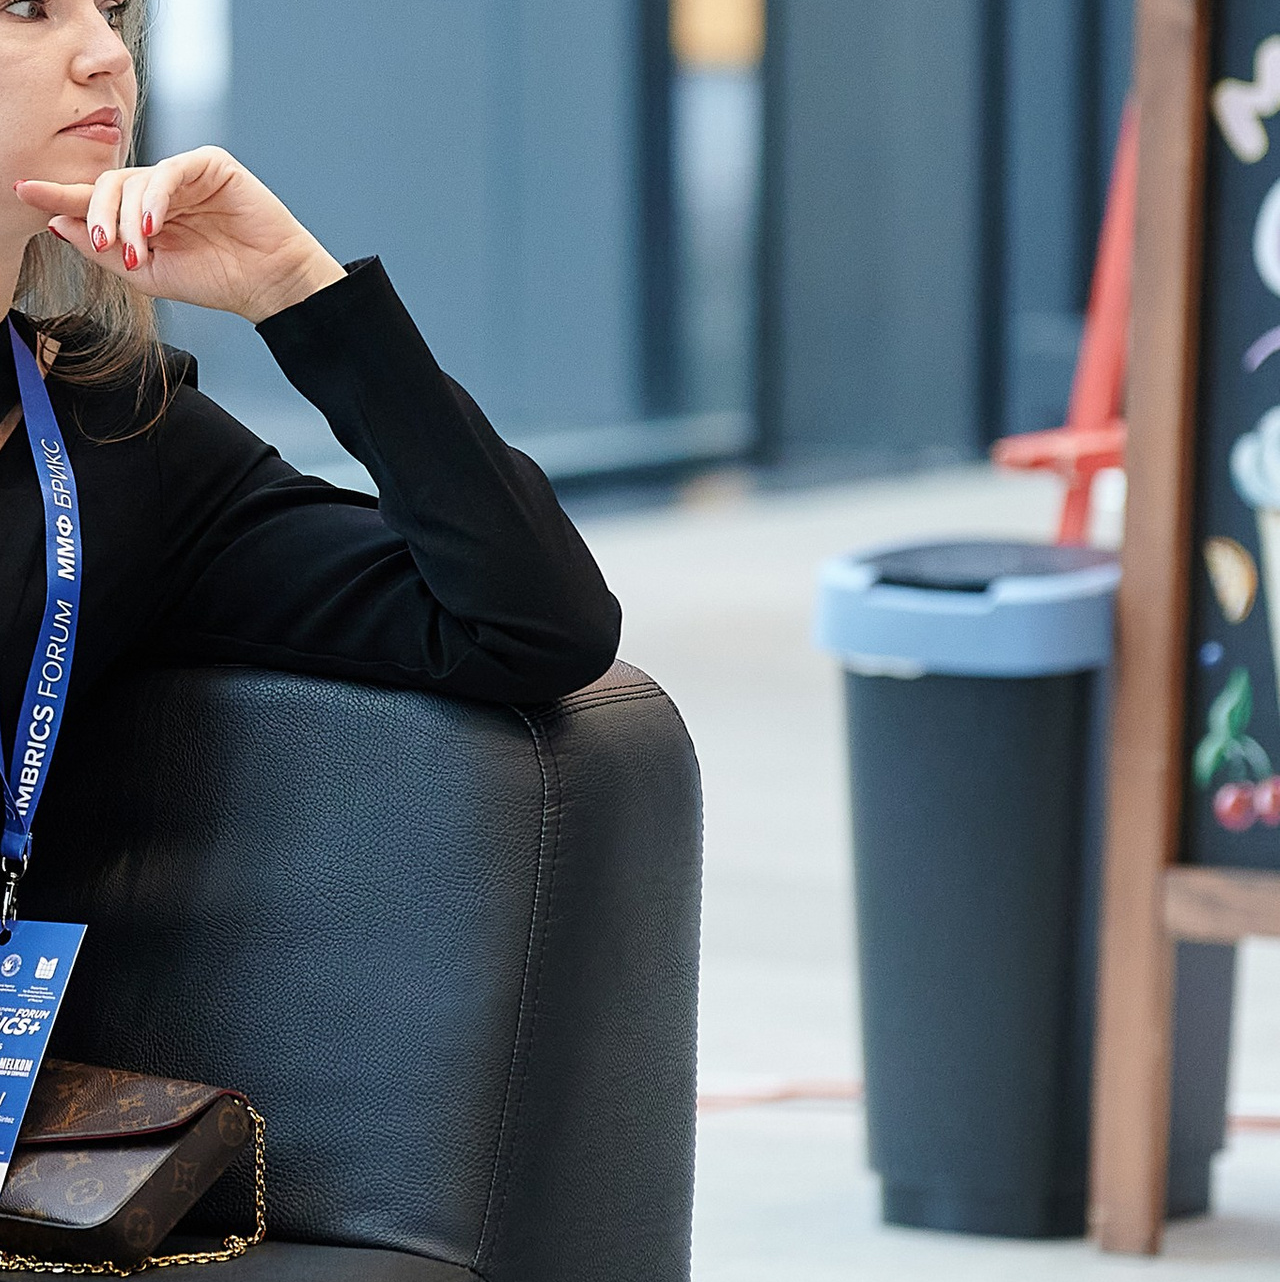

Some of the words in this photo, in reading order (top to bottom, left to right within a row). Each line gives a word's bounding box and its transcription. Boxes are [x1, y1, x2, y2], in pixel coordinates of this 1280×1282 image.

[41, 438, 72, 509] БРИКС
[56, 514, 75, 581] ММФ
[37, 599, 73, 699] FORUM
[15, 1008, 51, 1019] FORUM
